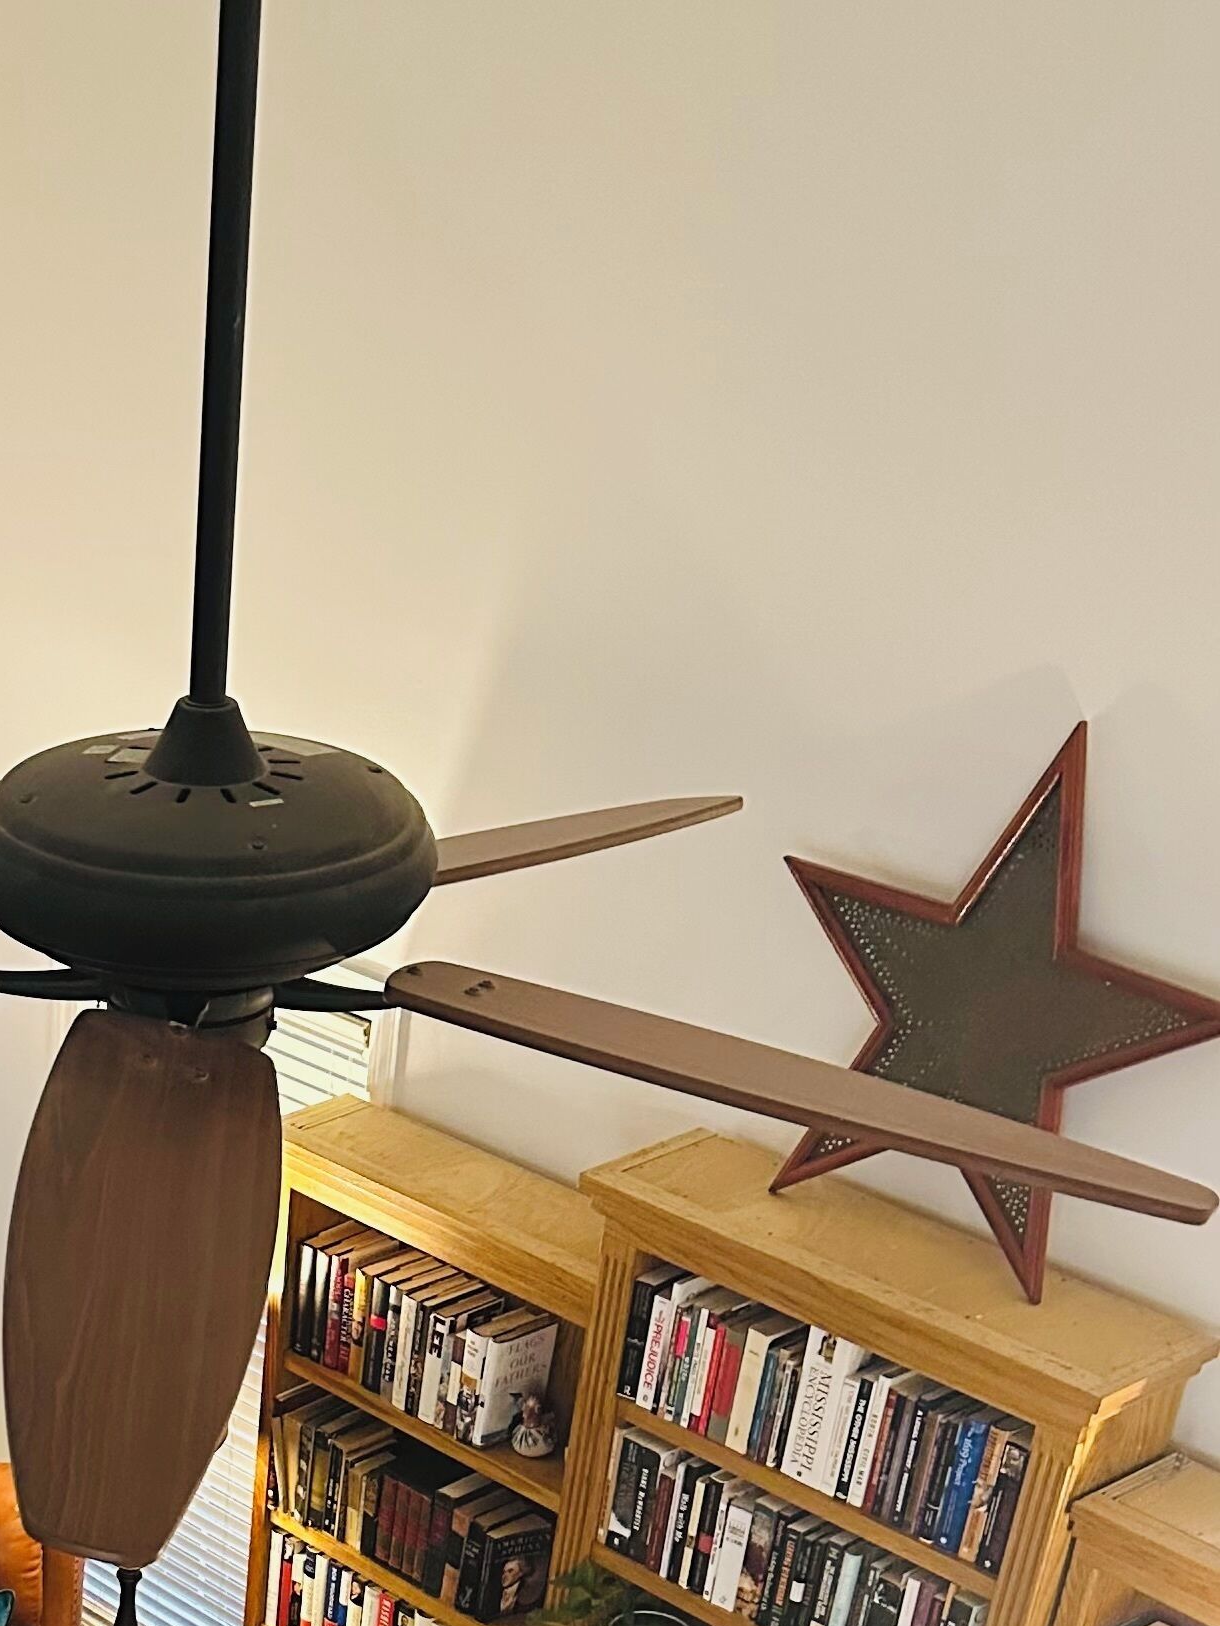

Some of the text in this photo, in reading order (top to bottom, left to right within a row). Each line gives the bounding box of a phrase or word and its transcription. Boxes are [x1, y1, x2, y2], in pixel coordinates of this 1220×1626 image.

[340, 1288, 351, 1342] CHARACTER
[429, 1316, 446, 1358] LEE
[643, 1322, 664, 1391] PREJUDICE
[790, 1365, 819, 1465] ENCYCLOPEDIA
[800, 1371, 832, 1472] MISSISSIPPI
[842, 1398, 866, 1482] THE OTHER MISSISSIPPI
[954, 1458, 967, 1486] Project
[960, 1437, 972, 1458] 1619
[640, 1467, 650, 1488] DIANE
[674, 1492, 690, 1543] Walk with Me
